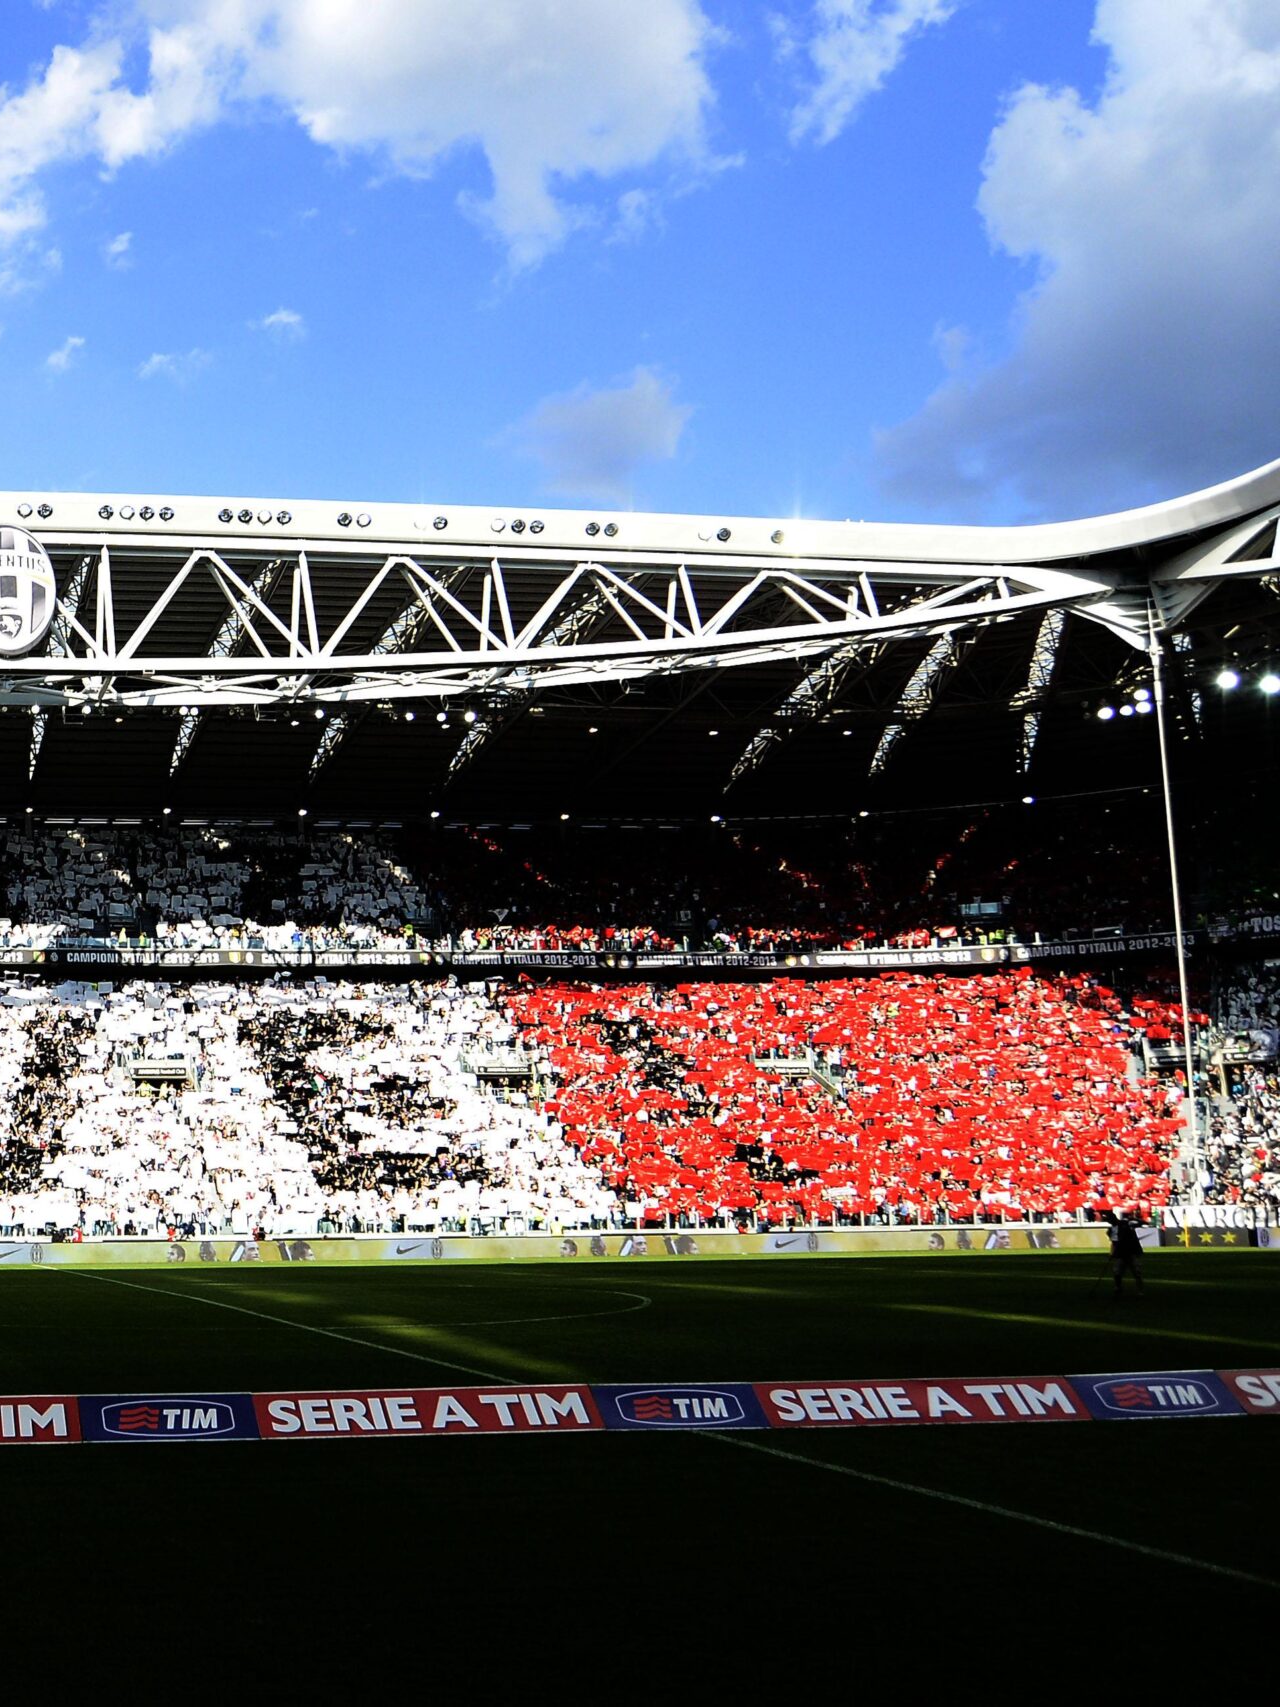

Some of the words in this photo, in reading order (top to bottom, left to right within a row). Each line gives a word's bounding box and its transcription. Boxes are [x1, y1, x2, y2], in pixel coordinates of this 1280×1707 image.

[67, 951, 119, 963] CAMPIONI
[261, 952, 312, 964] CAMPIONI
[315, 953, 355, 964] D'ITALIA
[452, 953, 502, 965] CAMPIONI
[504, 954, 542, 966] D'ITALIA
[545, 954, 596, 966] 2012-2013
[636, 954, 685, 966] CAMPIONI
[687, 954, 723, 966] D'ITALIA
[726, 954, 777, 966] 2012-2013
[816, 953, 867, 966] CAMPIONI
[870, 952, 909, 965] D'ITALIA
[1017, 946, 1078, 960] CAMPIONI
[1079, 940, 1125, 956] D'ITALIA
[769, 1385, 920, 1422] SERIE
[926, 1386, 973, 1418] A
[962, 1382, 1077, 1417] TIM
[1147, 1383, 1204, 1407] TIM
[267, 1396, 422, 1434] SERIE
[432, 1395, 479, 1430] A
[478, 1392, 590, 1428] TIM
[672, 1397, 729, 1419] TIM
[163, 1408, 218, 1430] TIM
